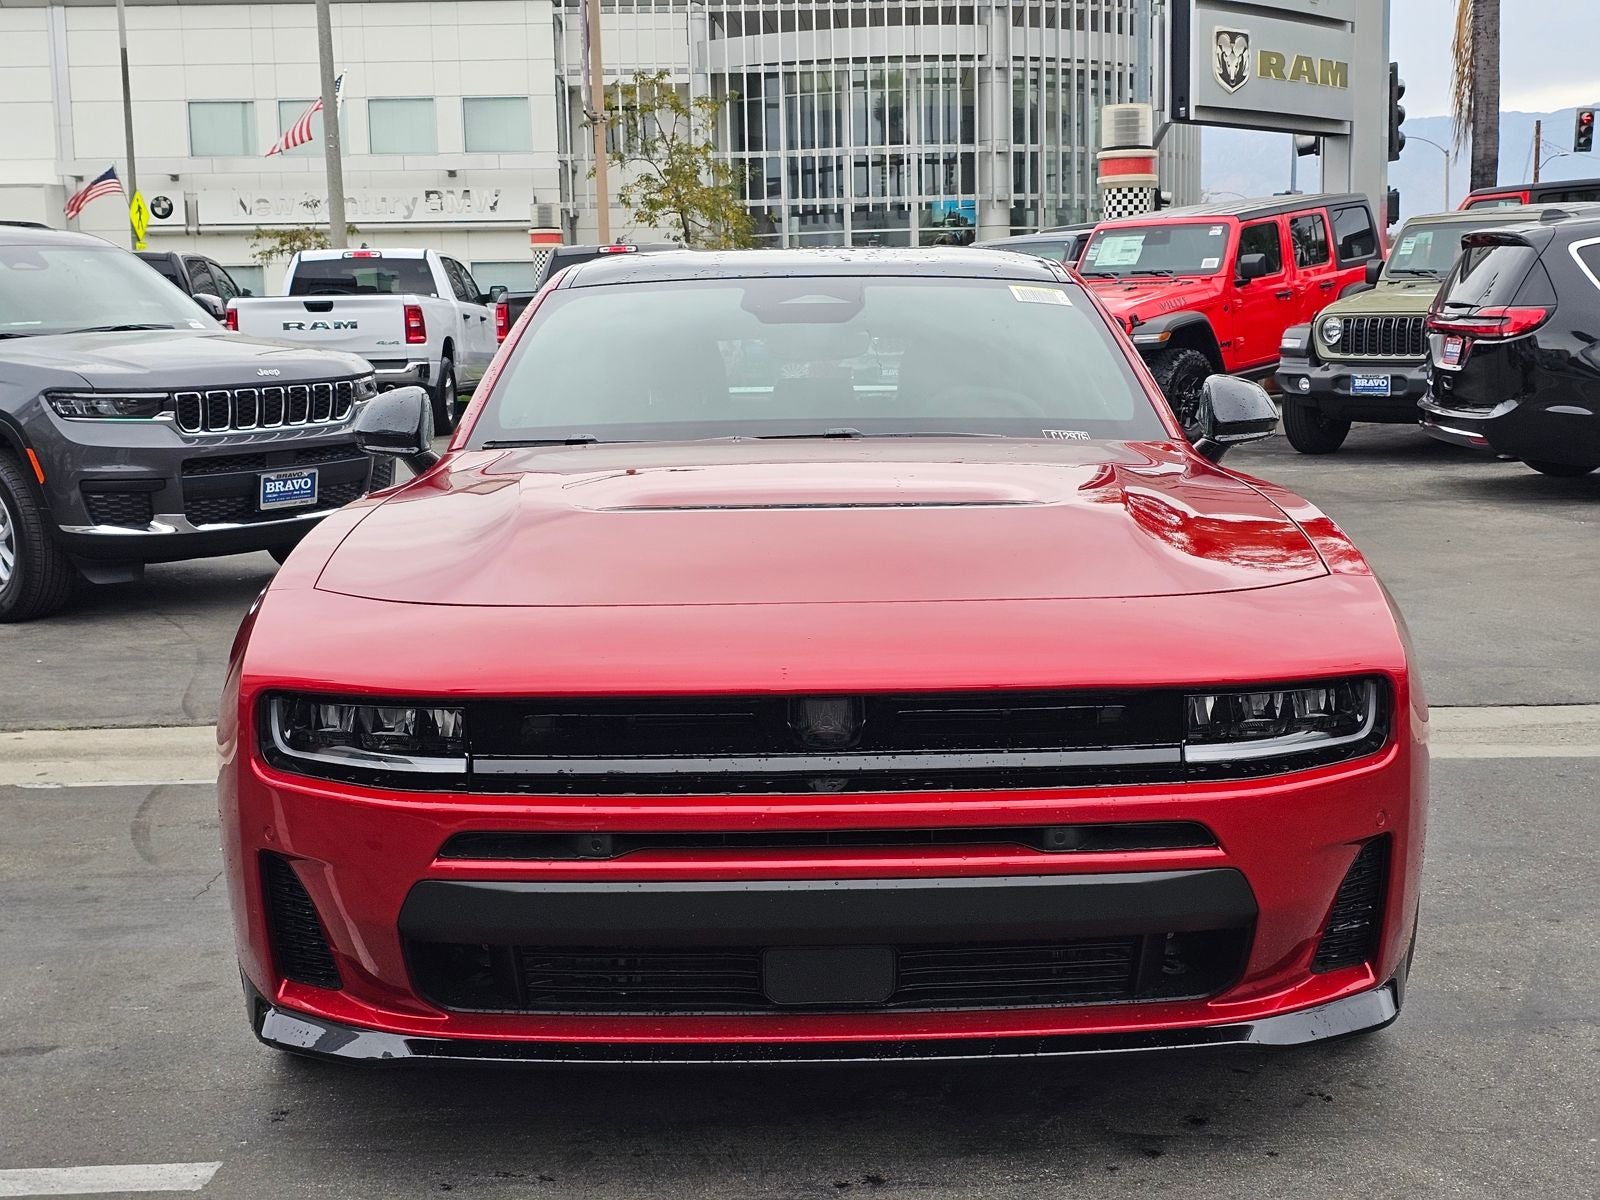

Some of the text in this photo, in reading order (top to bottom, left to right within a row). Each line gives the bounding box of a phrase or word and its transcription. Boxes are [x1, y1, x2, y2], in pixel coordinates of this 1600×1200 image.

[1258, 49, 1348, 89] RAM
[233, 191, 296, 216] New
[424, 188, 502, 215] BMW
[282, 320, 359, 331] RAM
[257, 368, 281, 377] Jeep
[1354, 379, 1388, 387] BRAVO
[276, 471, 302, 479] BRAVO
[265, 478, 311, 493] BRAVO
